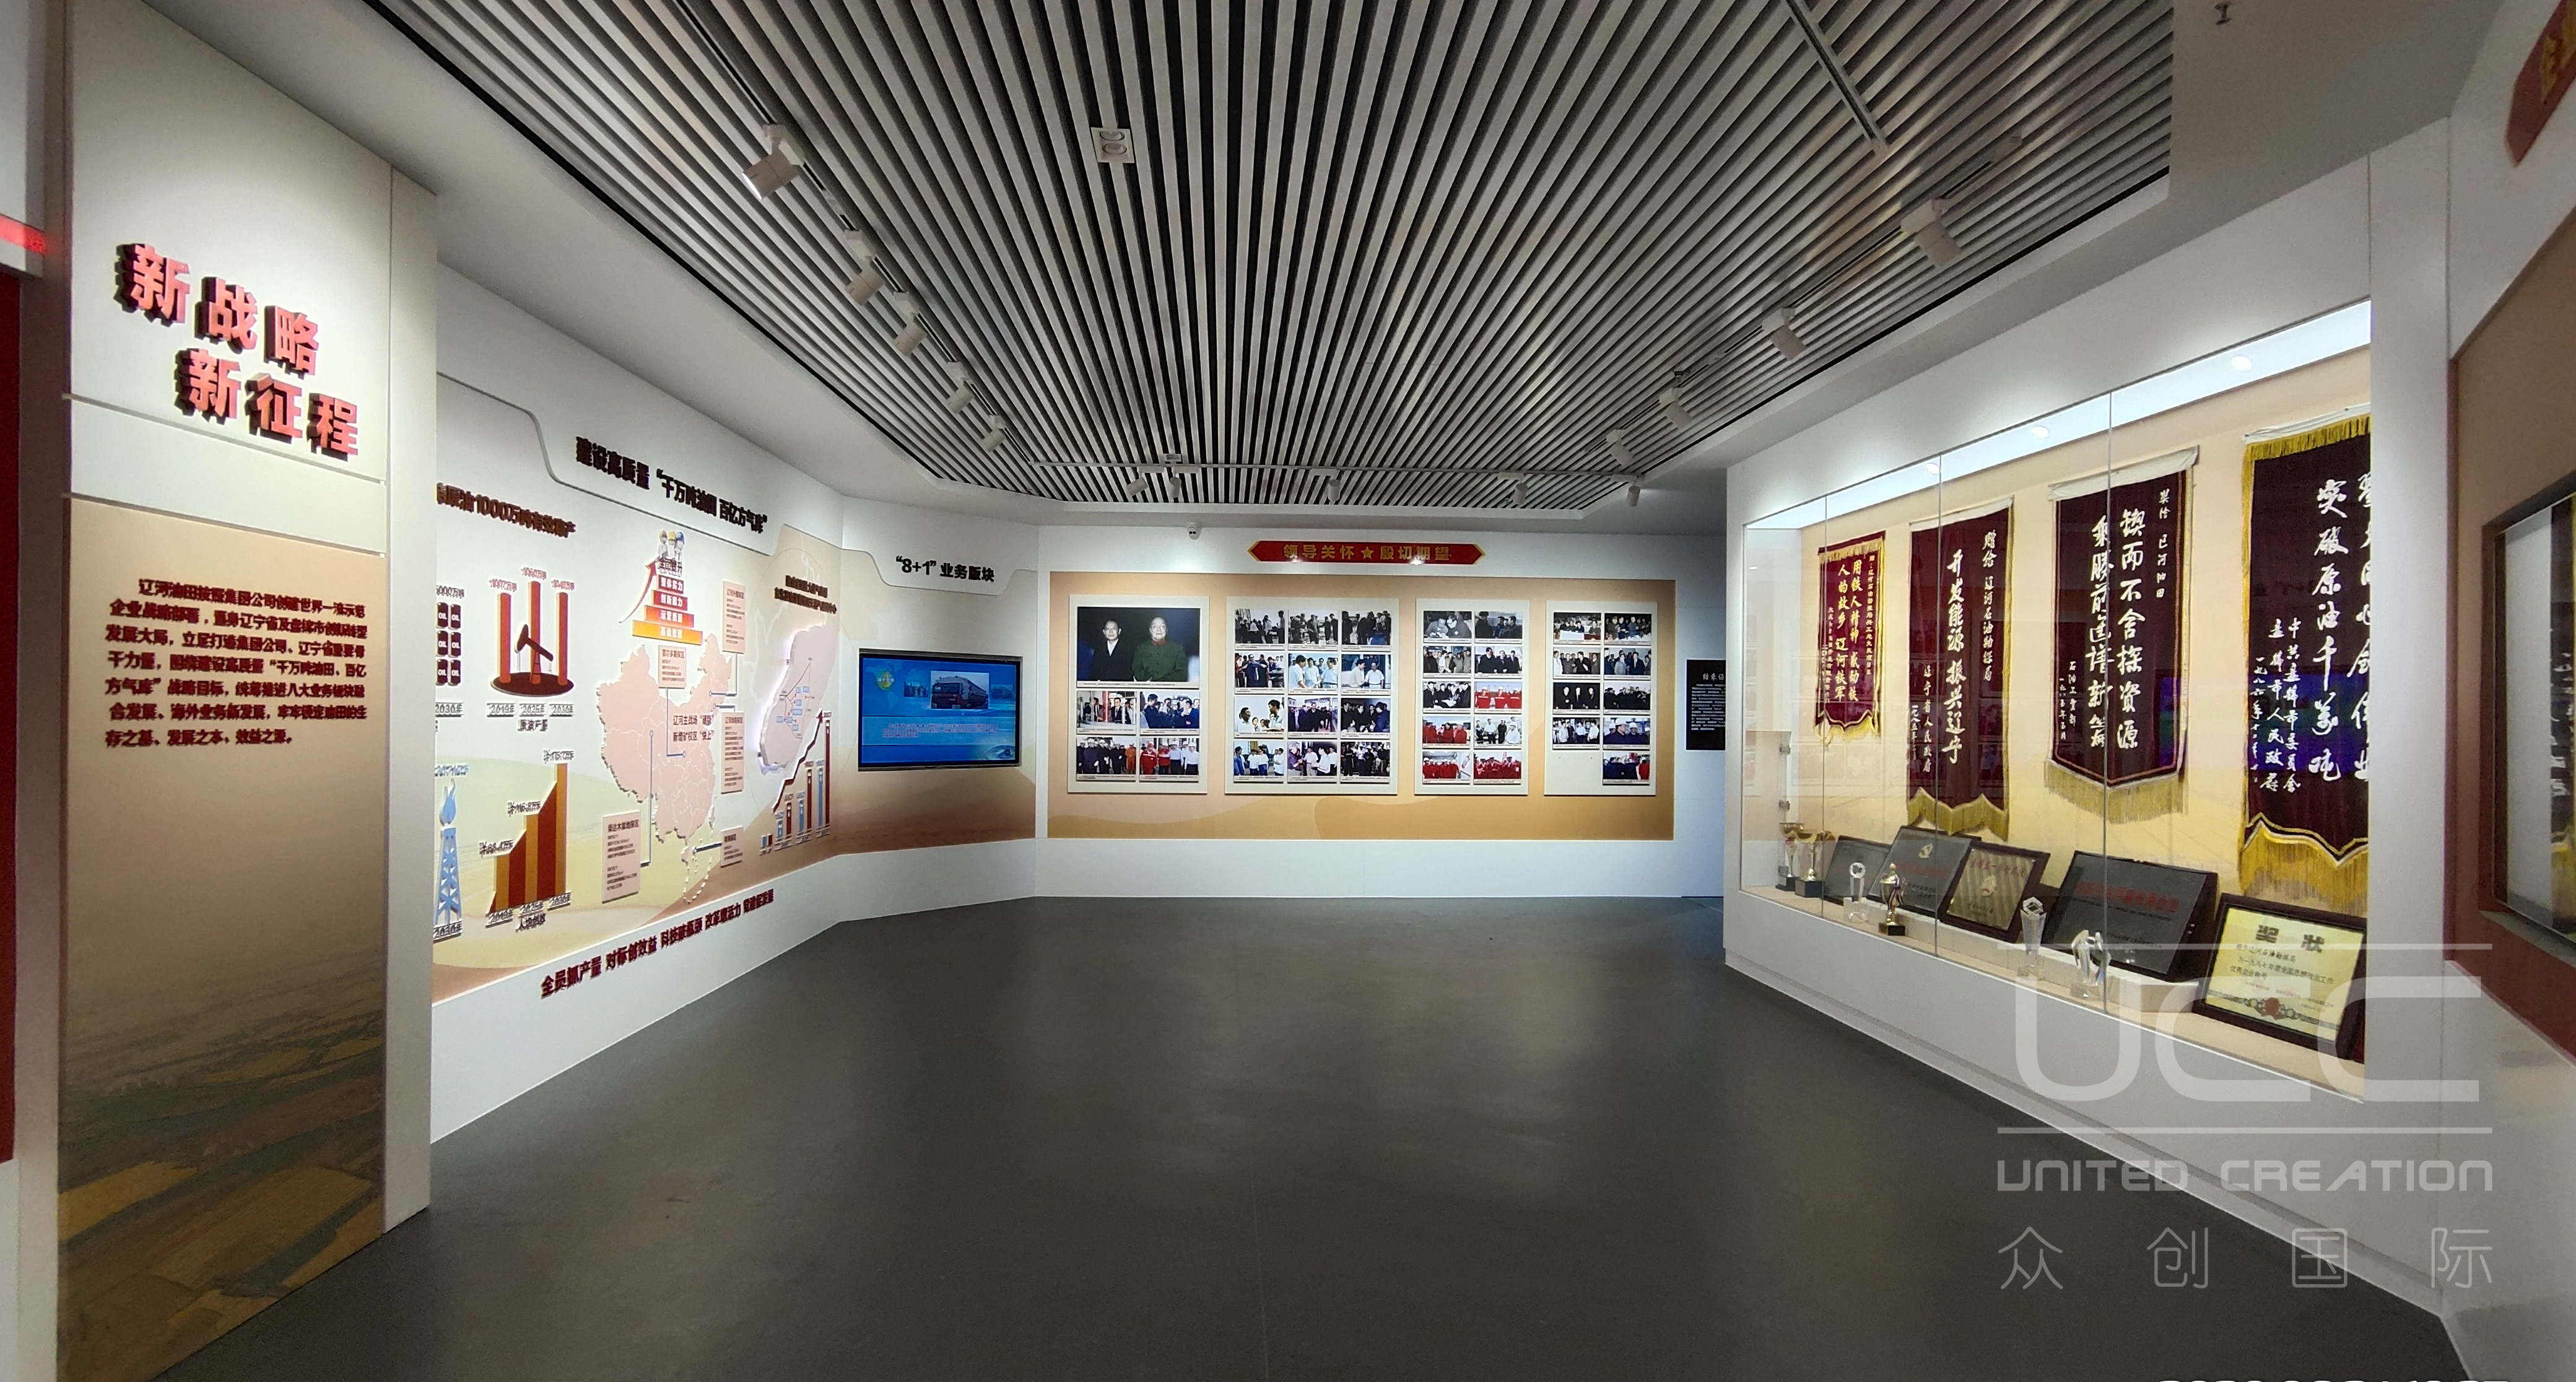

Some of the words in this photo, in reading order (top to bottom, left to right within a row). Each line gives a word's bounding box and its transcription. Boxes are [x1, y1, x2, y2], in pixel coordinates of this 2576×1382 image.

[114, 243, 320, 377] 新战略
[174, 347, 358, 461] 新征程
[576, 436, 650, 490] 建设高质量
[895, 555, 937, 576] “8+1”
[939, 562, 995, 583] 业务版块
[1283, 544, 1355, 560] 领导关怀
[1379, 545, 1451, 561] 殷切期望
[1837, 563, 1851, 630] 人的故乡
[1834, 637, 1849, 702] 辽河铁军
[541, 955, 603, 999] 全员抓产量
